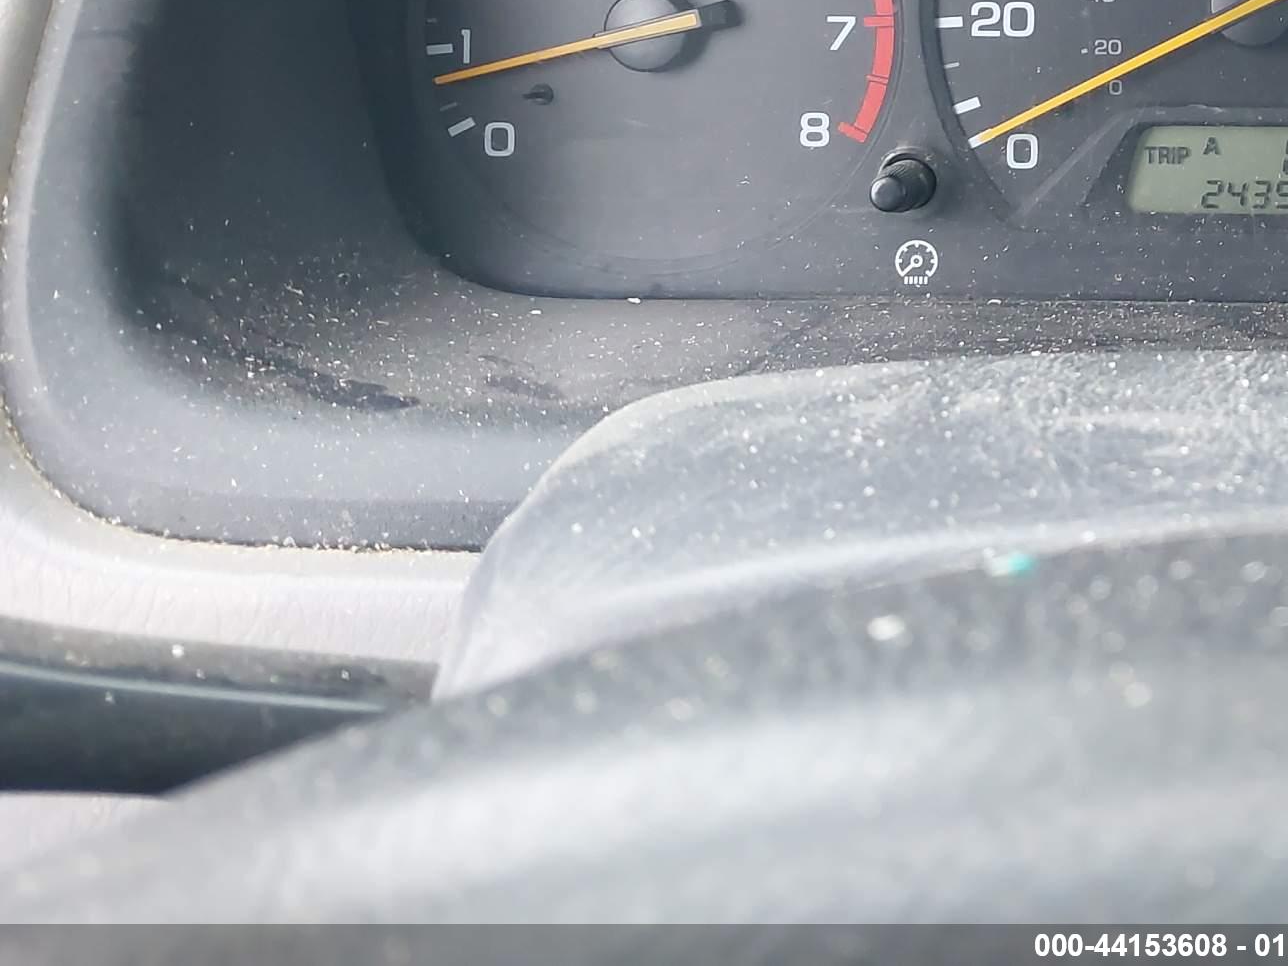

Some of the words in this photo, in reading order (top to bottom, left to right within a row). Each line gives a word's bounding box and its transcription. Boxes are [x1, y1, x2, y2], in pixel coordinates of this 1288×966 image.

[826, 16, 856, 51] 7
[970, 1, 1035, 37] 20
[461, 29, 470, 63] 1
[1094, 39, 1122, 55] 20
[1108, 79, 1122, 95] 0
[484, 121, 515, 157] 0
[799, 112, 830, 147] 8
[1006, 133, 1038, 169] 0
[1144, 146, 1191, 165] TRIP
[1203, 137, 1221, 155] A
